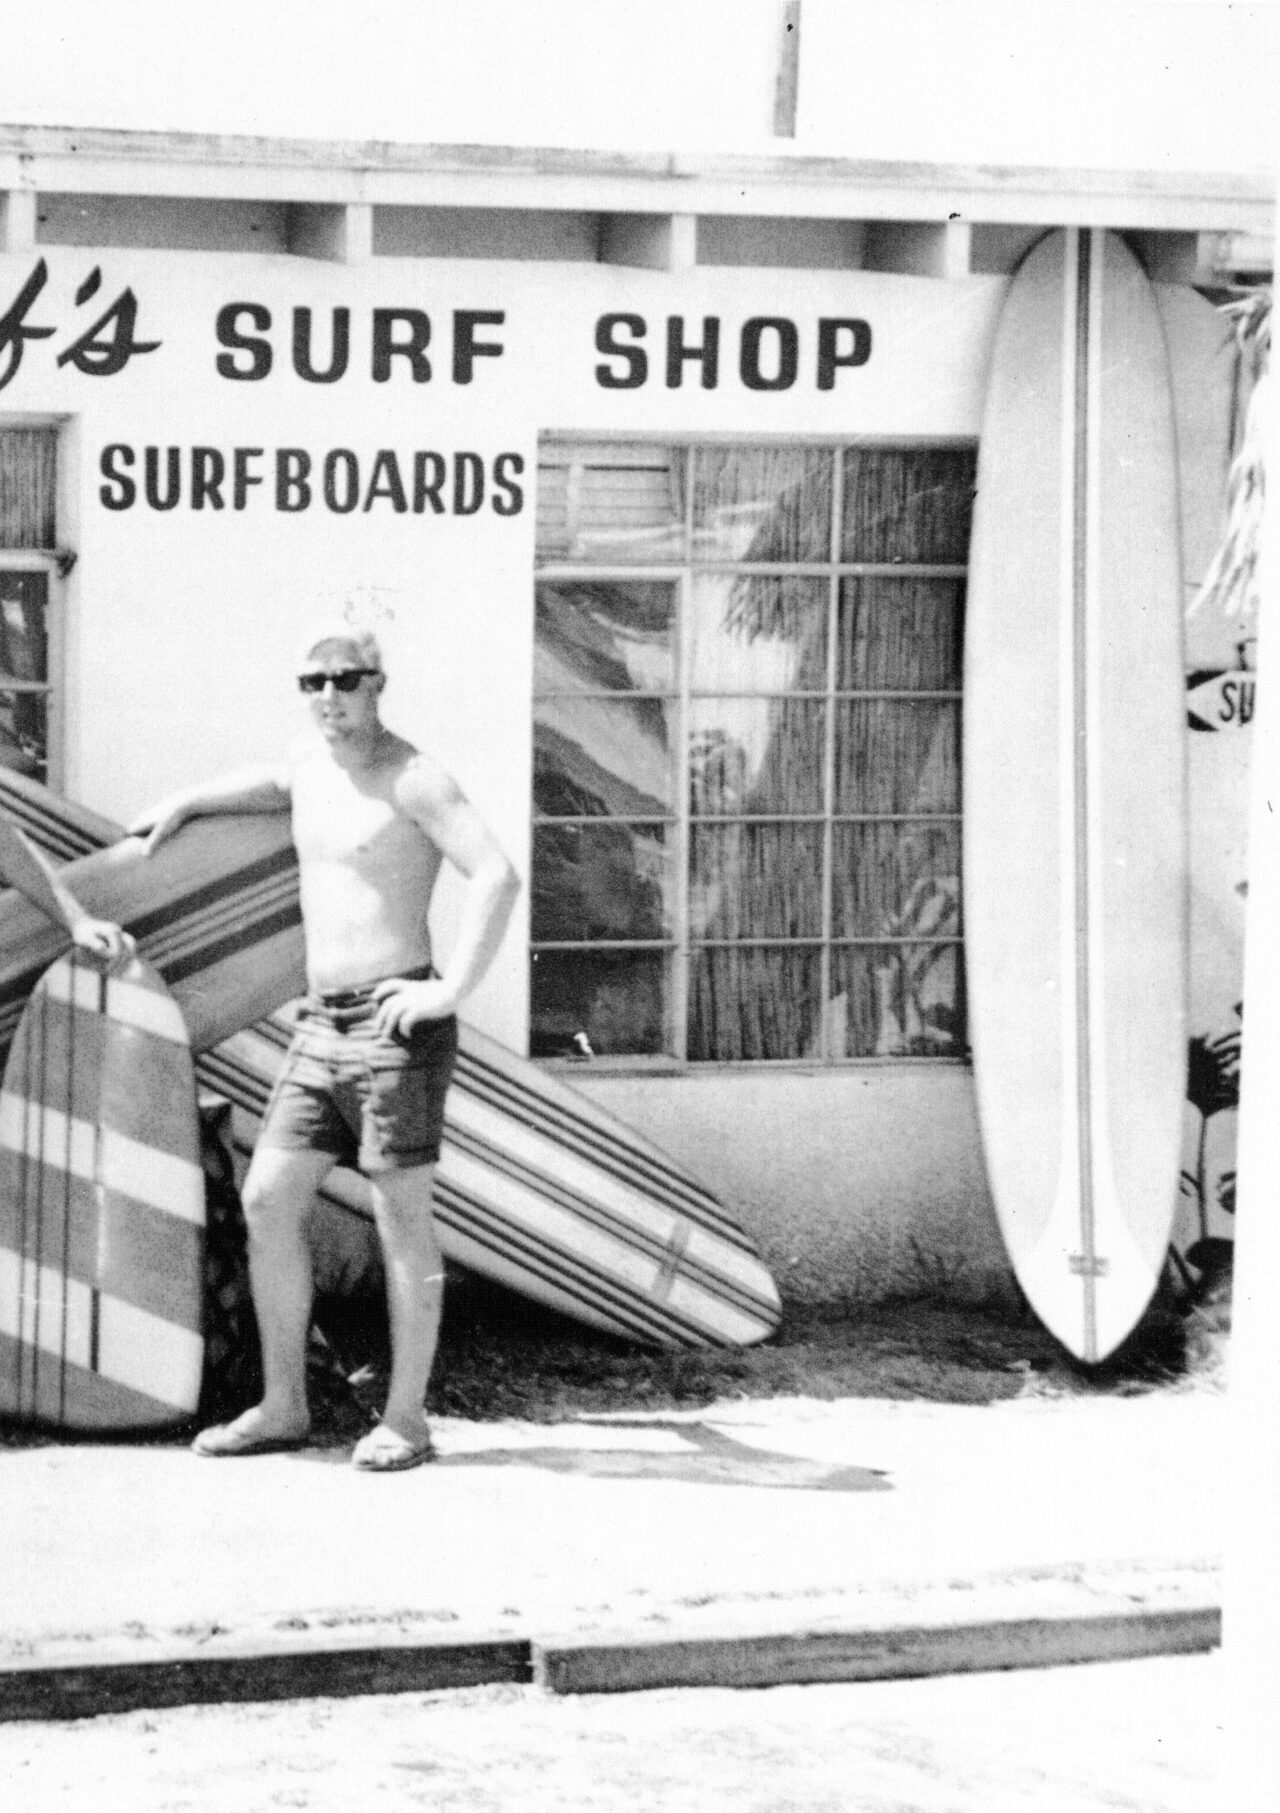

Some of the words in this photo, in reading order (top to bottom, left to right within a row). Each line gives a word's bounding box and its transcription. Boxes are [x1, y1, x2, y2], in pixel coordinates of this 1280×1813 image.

[216, 302, 507, 386] SURF
[595, 314, 875, 392] SHOP
[100, 444, 525, 518] SURFBOARDS
